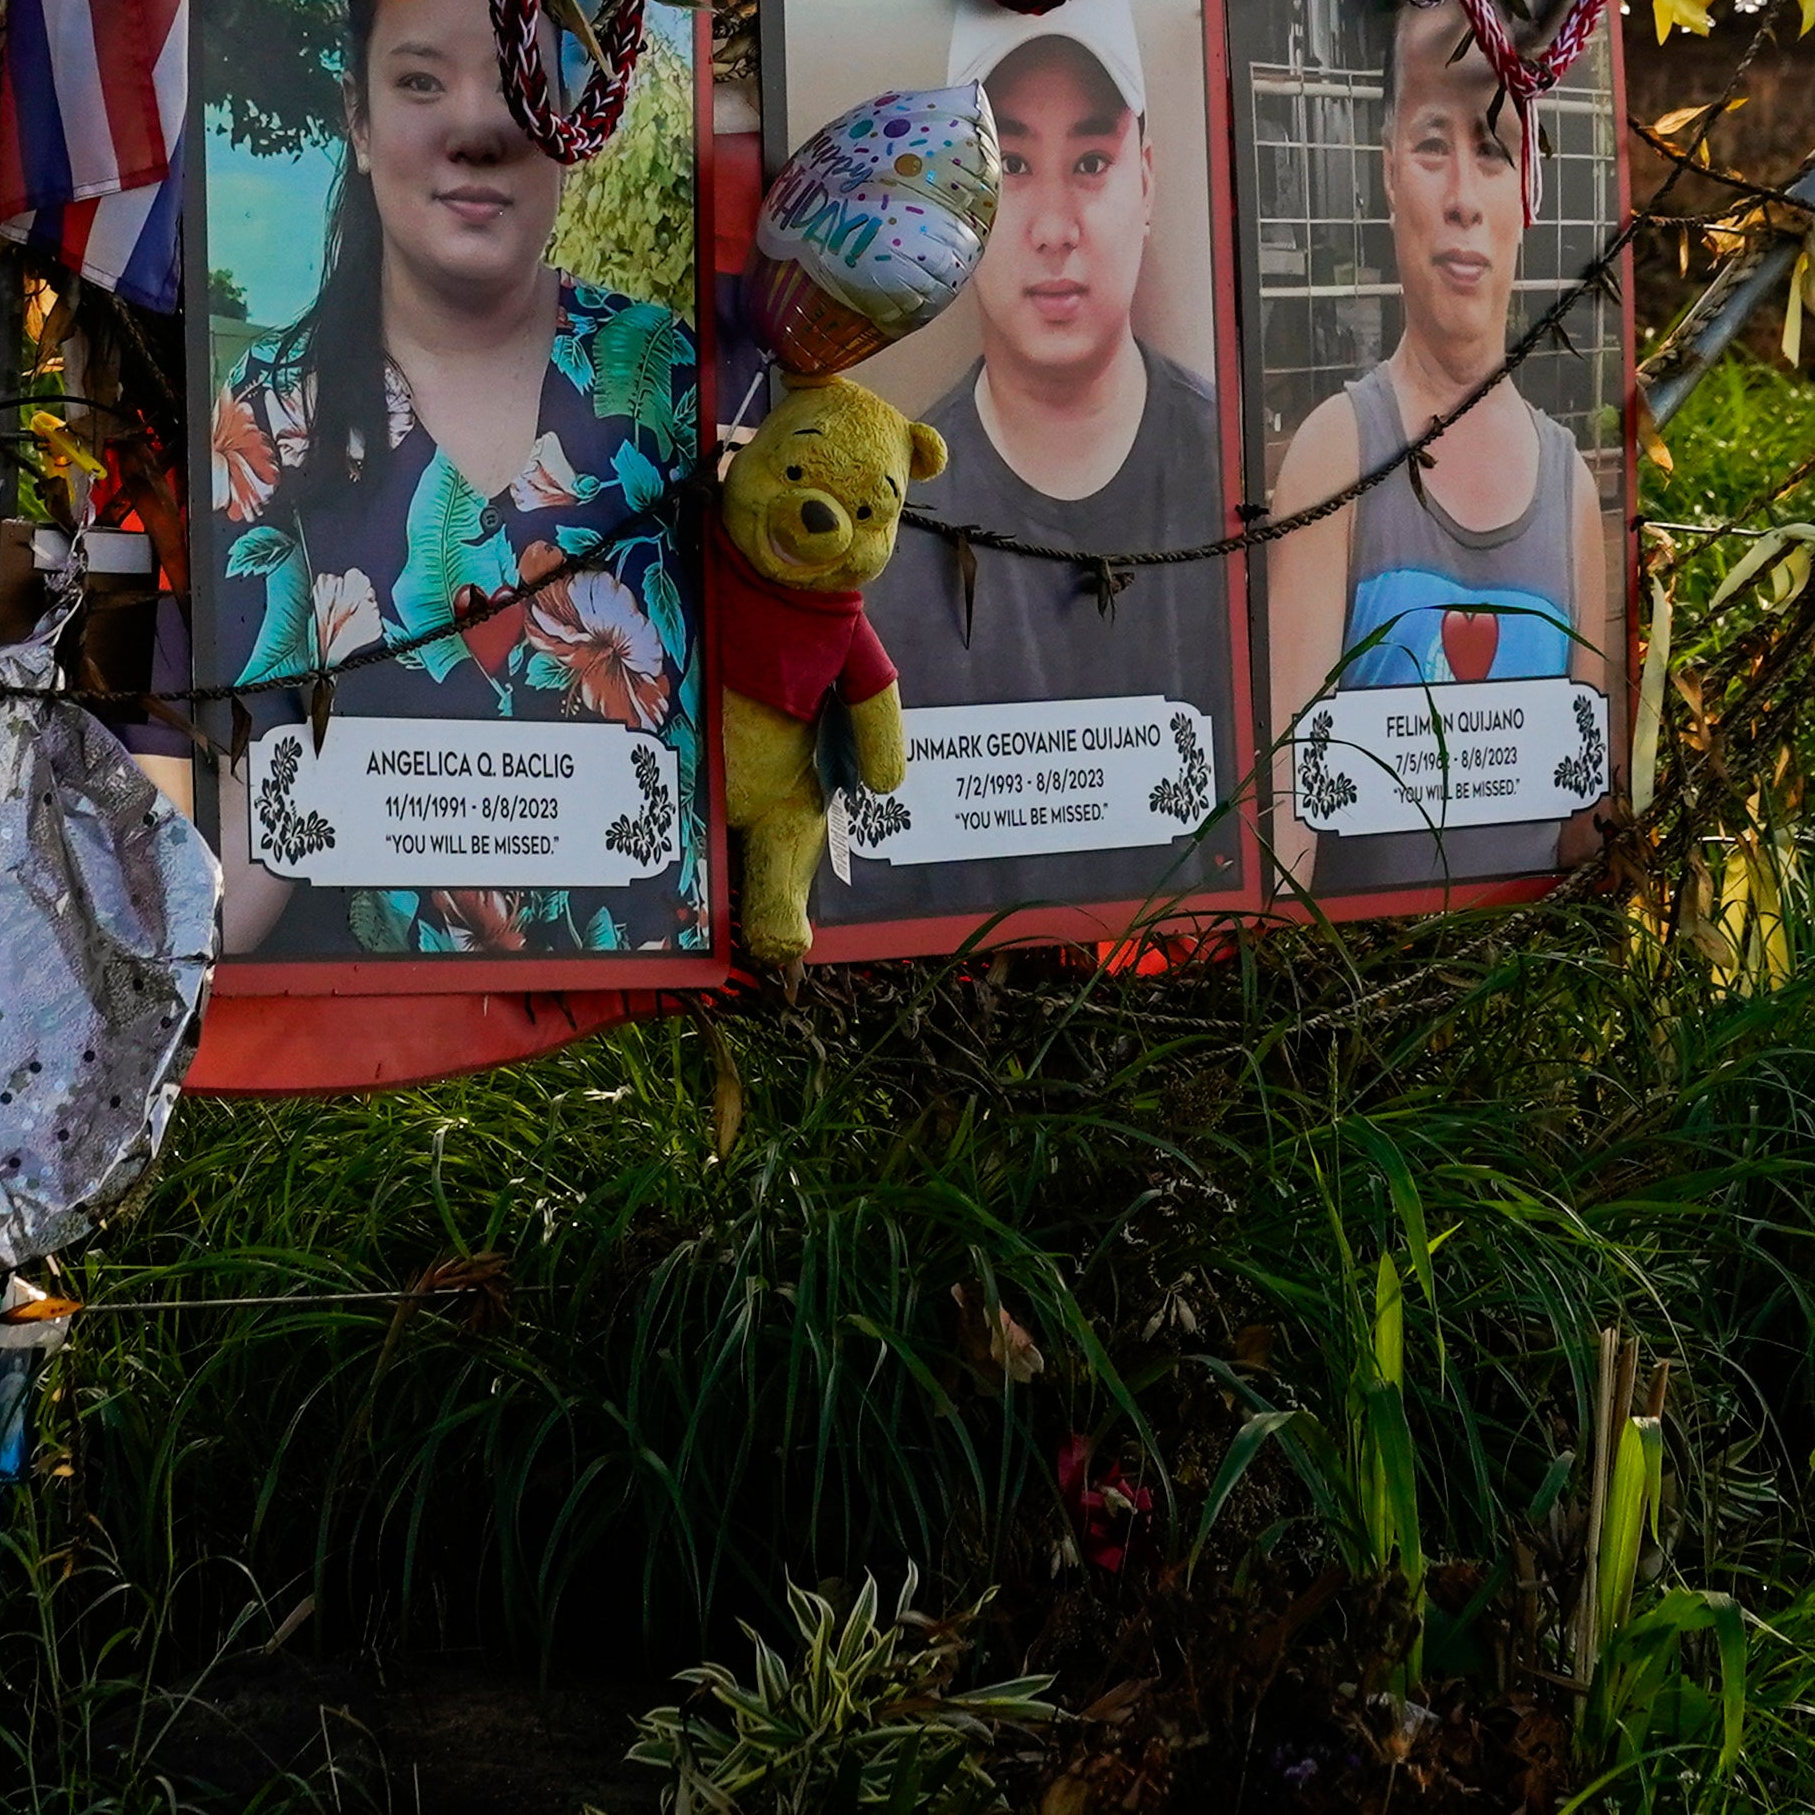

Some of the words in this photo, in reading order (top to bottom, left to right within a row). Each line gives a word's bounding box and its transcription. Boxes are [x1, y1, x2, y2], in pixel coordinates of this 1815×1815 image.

[1386, 712, 1454, 738] FELIMN
[1457, 707, 1525, 733] QUIJANO
[986, 728, 1078, 758] GEOVANIE
[1082, 723, 1162, 751] QUIJANO
[366, 749, 473, 777] ANGELICA
[477, 751, 497, 778] Q.
[502, 752, 575, 779] BACLIG
[1461, 746, 1518, 770] 8/8/2023
[956, 772, 1024, 800] 7/2/1993
[1036, 767, 1105, 795] 8/8/2023
[1455, 781, 1471, 799] BE
[385, 793, 467, 822] 11/11/1991
[481, 794, 559, 822] 8/8/2023
[994, 809, 1028, 829] WILL
[1030, 807, 1048, 826] BE
[429, 834, 468, 855] WILL
[471, 834, 491, 855] BE
